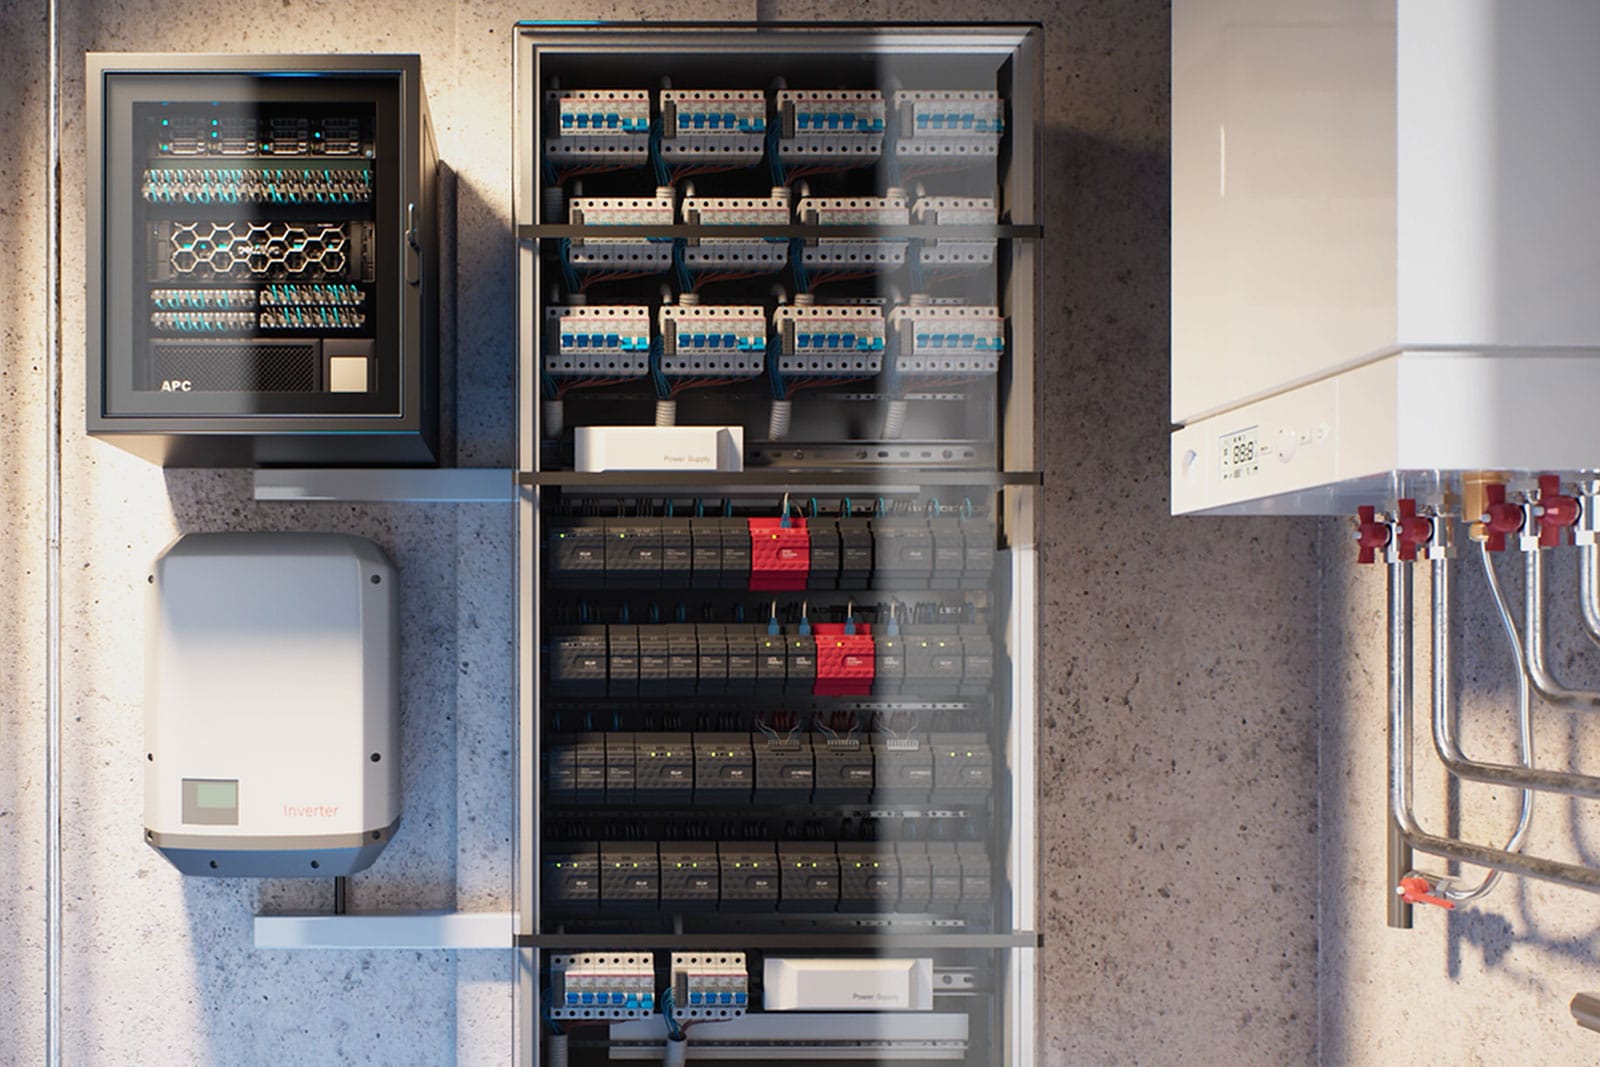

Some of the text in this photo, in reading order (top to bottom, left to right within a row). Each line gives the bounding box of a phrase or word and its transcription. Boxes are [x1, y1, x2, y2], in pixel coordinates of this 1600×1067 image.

[160, 380, 192, 392] APC
[663, 455, 710, 465] Power Supply
[283, 804, 338, 817] Inverter
[852, 992, 874, 1001] Power
